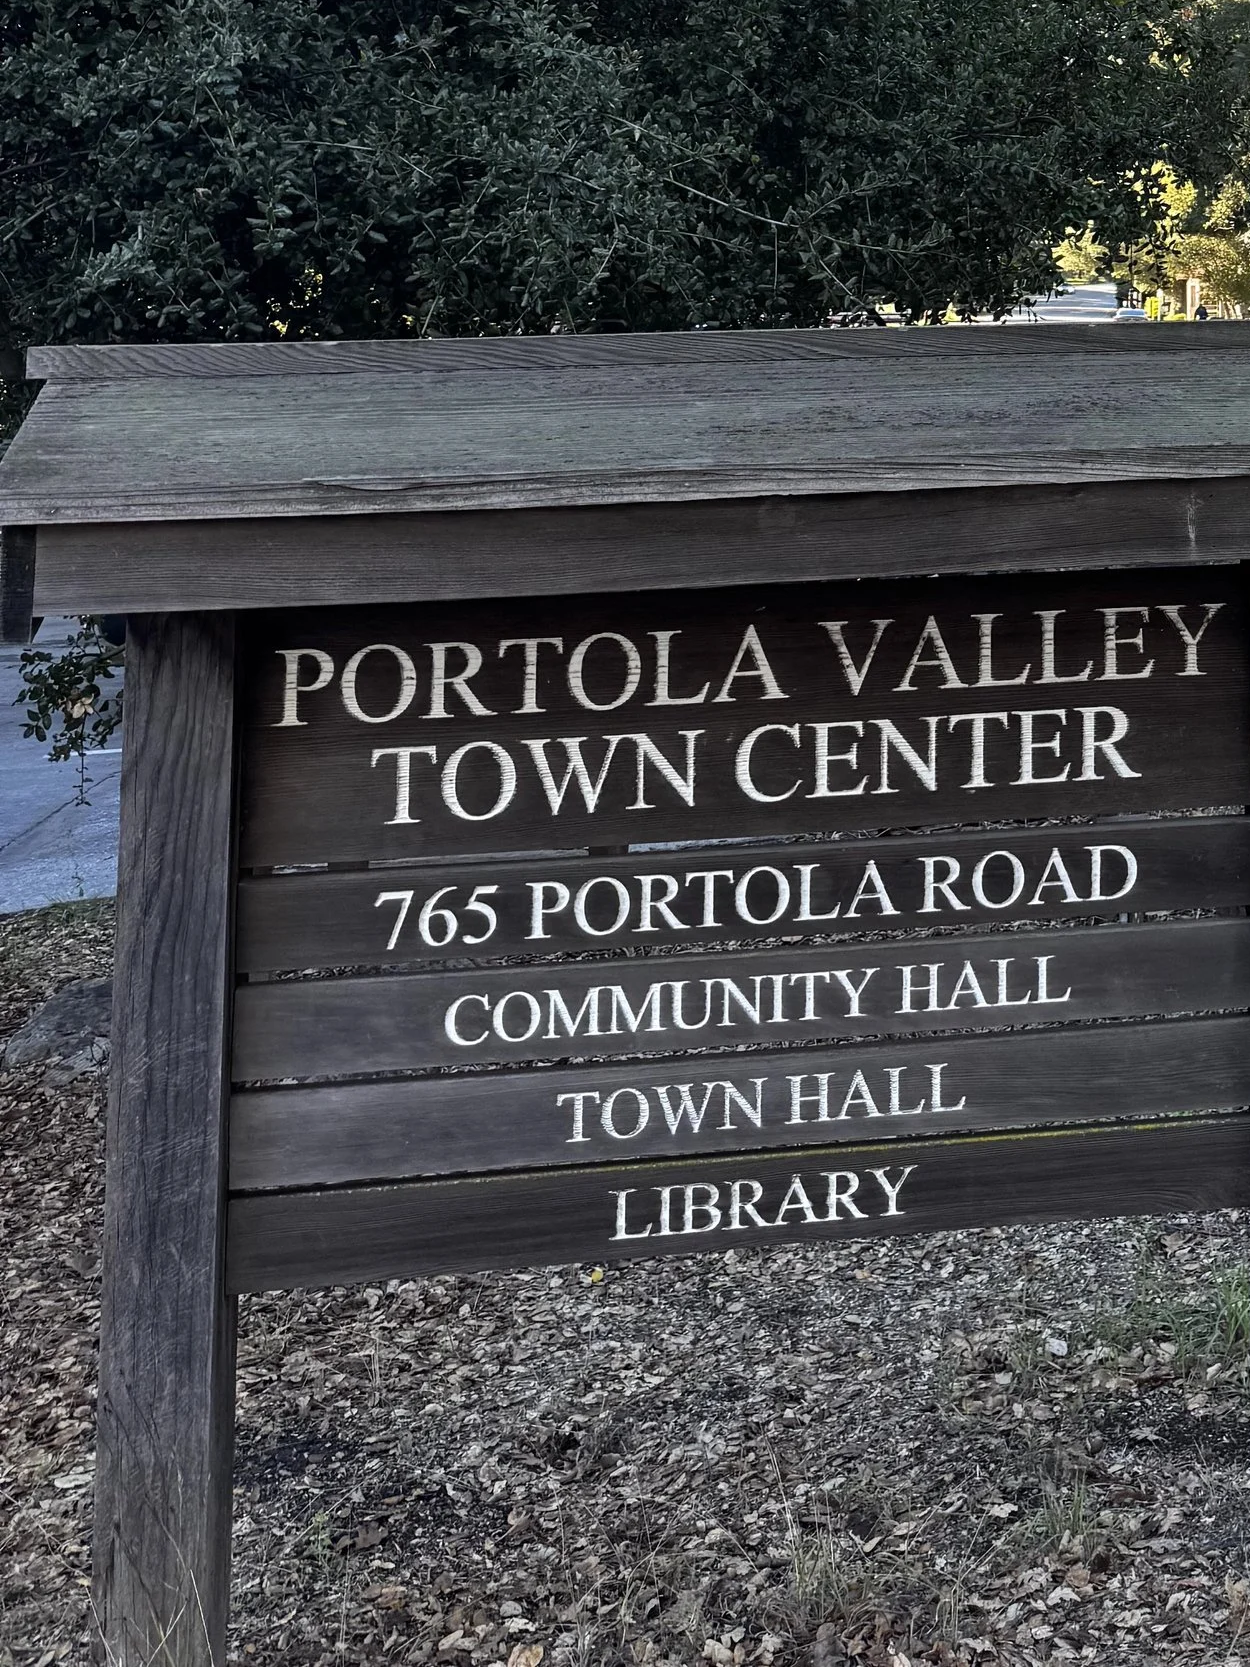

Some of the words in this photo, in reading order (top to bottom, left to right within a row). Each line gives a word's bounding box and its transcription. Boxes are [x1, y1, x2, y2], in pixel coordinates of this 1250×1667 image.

[274, 625, 789, 726] PORTOLA
[819, 603, 1226, 695] VALLEY
[371, 730, 705, 824] TOWN
[735, 706, 1141, 801] CENTER
[374, 885, 499, 950] 765
[526, 861, 900, 939] PORTOLA
[917, 845, 1138, 912] ROAD
[445, 968, 880, 1045] COMMUNITY
[894, 955, 1071, 1013] HALL
[556, 1078, 768, 1142] TOWN
[785, 1063, 966, 1124] HALL
[609, 1165, 918, 1240] LIBRARY
